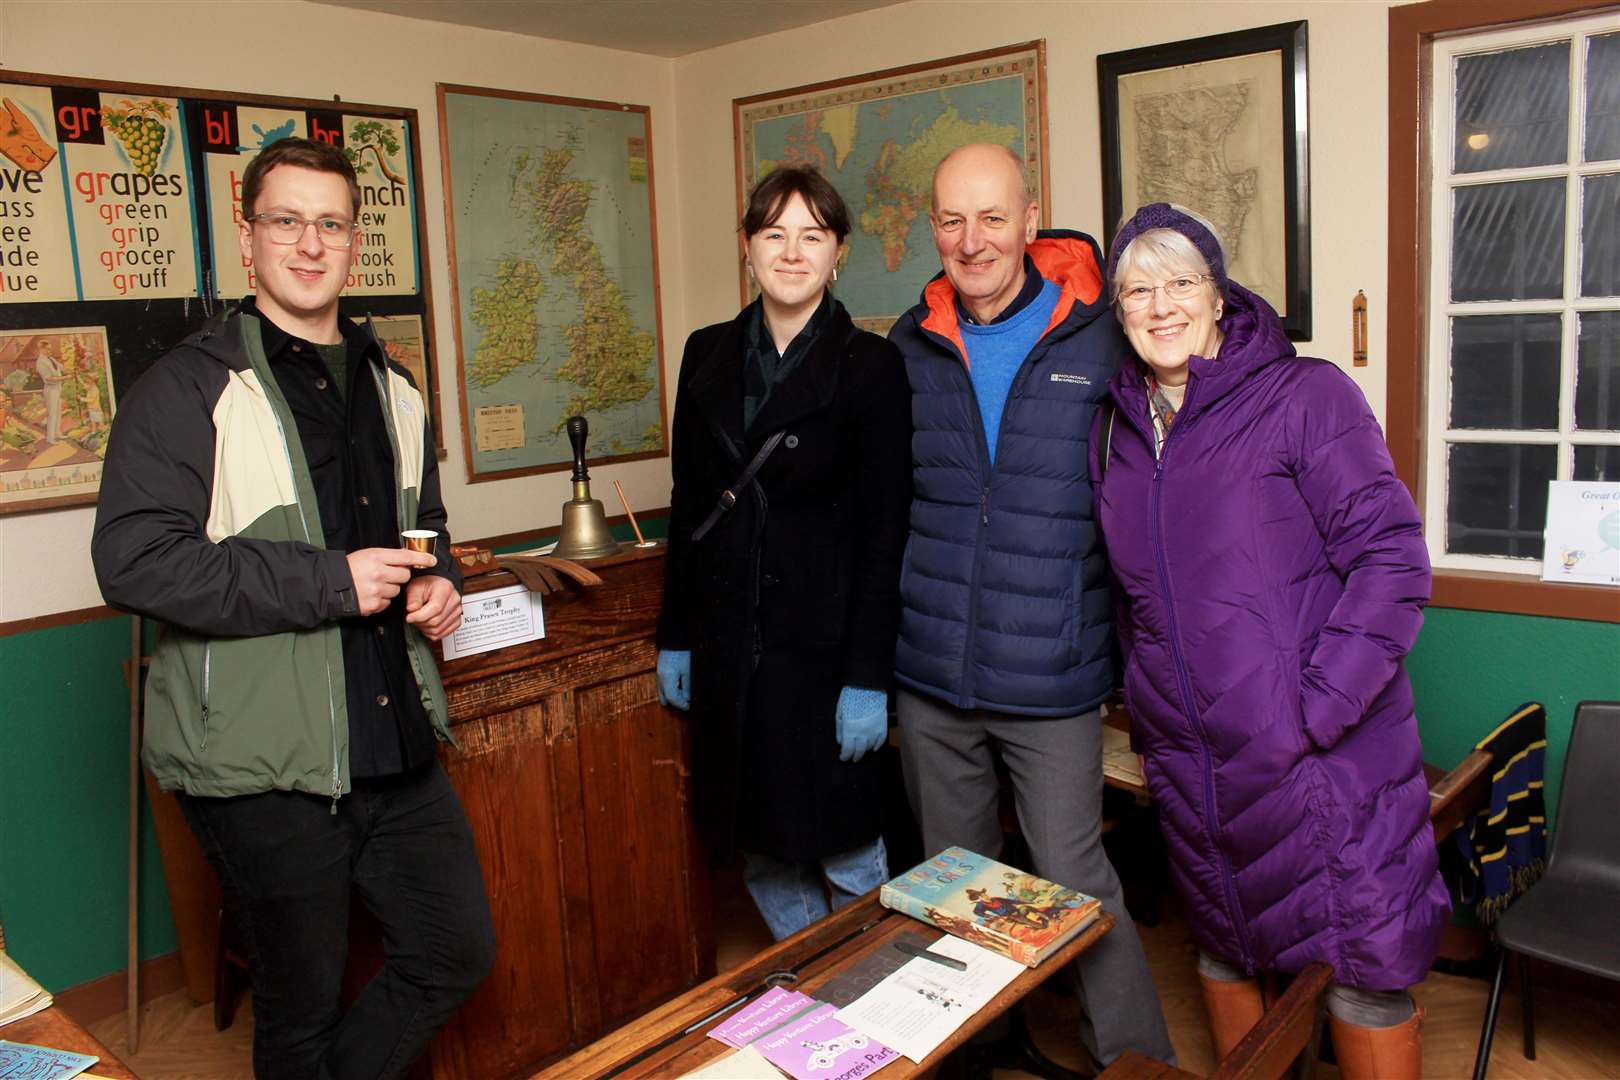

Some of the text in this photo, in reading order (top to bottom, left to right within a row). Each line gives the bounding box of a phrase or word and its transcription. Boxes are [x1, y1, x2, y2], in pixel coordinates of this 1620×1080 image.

[58, 105, 97, 139] gr
[204, 109, 231, 145] bl
[311, 117, 340, 145] br
[75, 171, 182, 203] grapes
[99, 203, 168, 225] green
[111, 222, 160, 248] grip
[100, 249, 175, 272] grocer
[113, 268, 167, 295] gruff
[464, 614, 480, 624] King
[500, 607, 521, 617] Trophy
